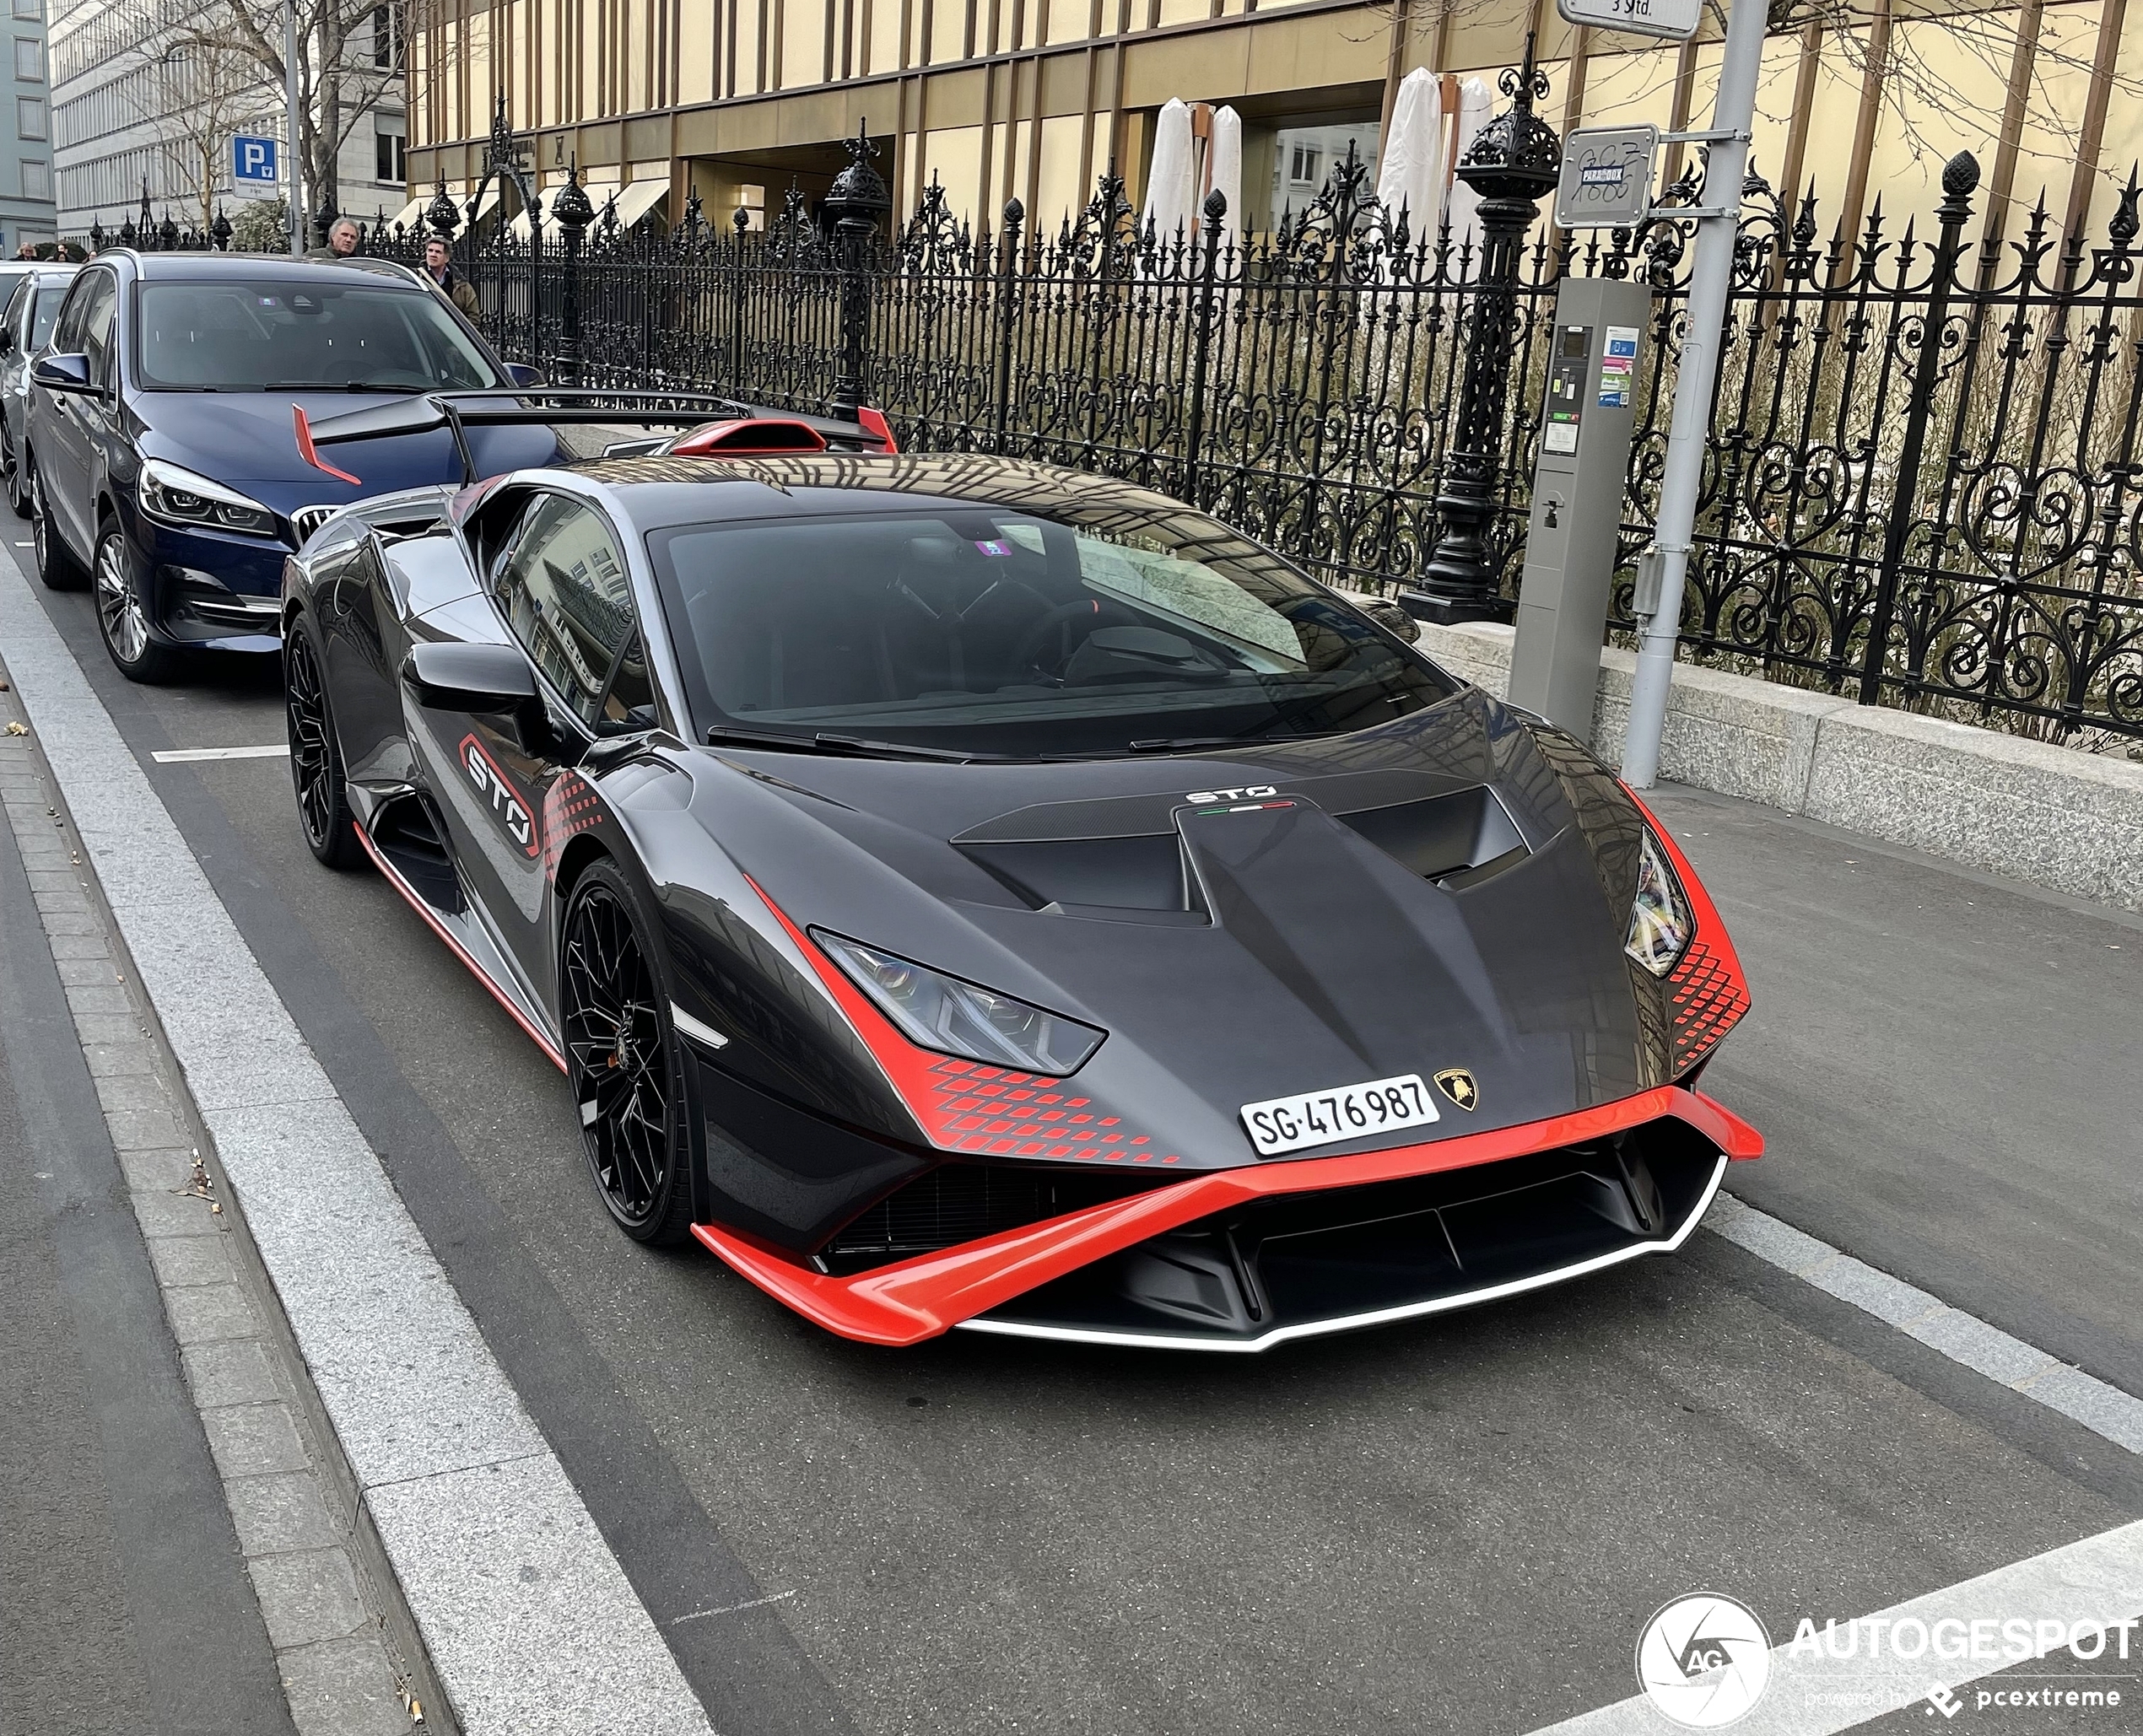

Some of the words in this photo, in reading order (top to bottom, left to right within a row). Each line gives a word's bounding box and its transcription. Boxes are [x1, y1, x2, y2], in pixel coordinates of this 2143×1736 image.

[245, 143, 265, 174] P
[468, 746, 530, 844] STO
[1185, 785, 1277, 804] STO
